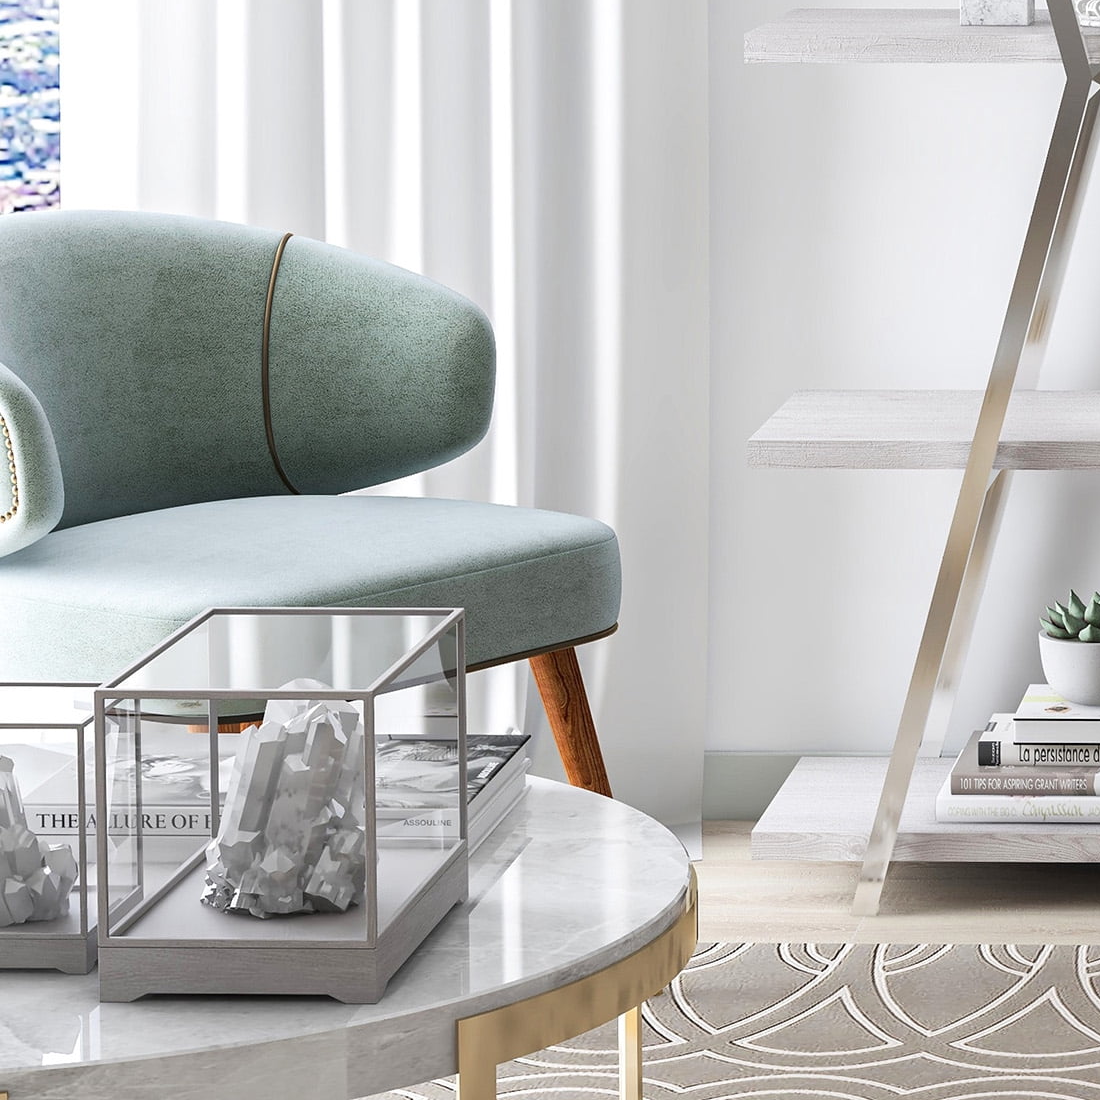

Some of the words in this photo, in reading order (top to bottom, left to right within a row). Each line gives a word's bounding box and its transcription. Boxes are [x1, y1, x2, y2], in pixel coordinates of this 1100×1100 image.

[1019, 745, 1030, 763] La
[1033, 745, 1090, 767] persistance
[959, 777, 971, 790] 101
[973, 777, 987, 790] TIPS
[988, 777, 1002, 790] FOR
[1002, 777, 1033, 790] ASPIRING
[1034, 777, 1059, 790] GRANT
[1059, 777, 1088, 790] WRITERS
[35, 813, 80, 829] THE
[86, 813, 167, 830] ALURE
[171, 813, 199, 830] OF
[403, 819, 452, 827] ASSOULINE
